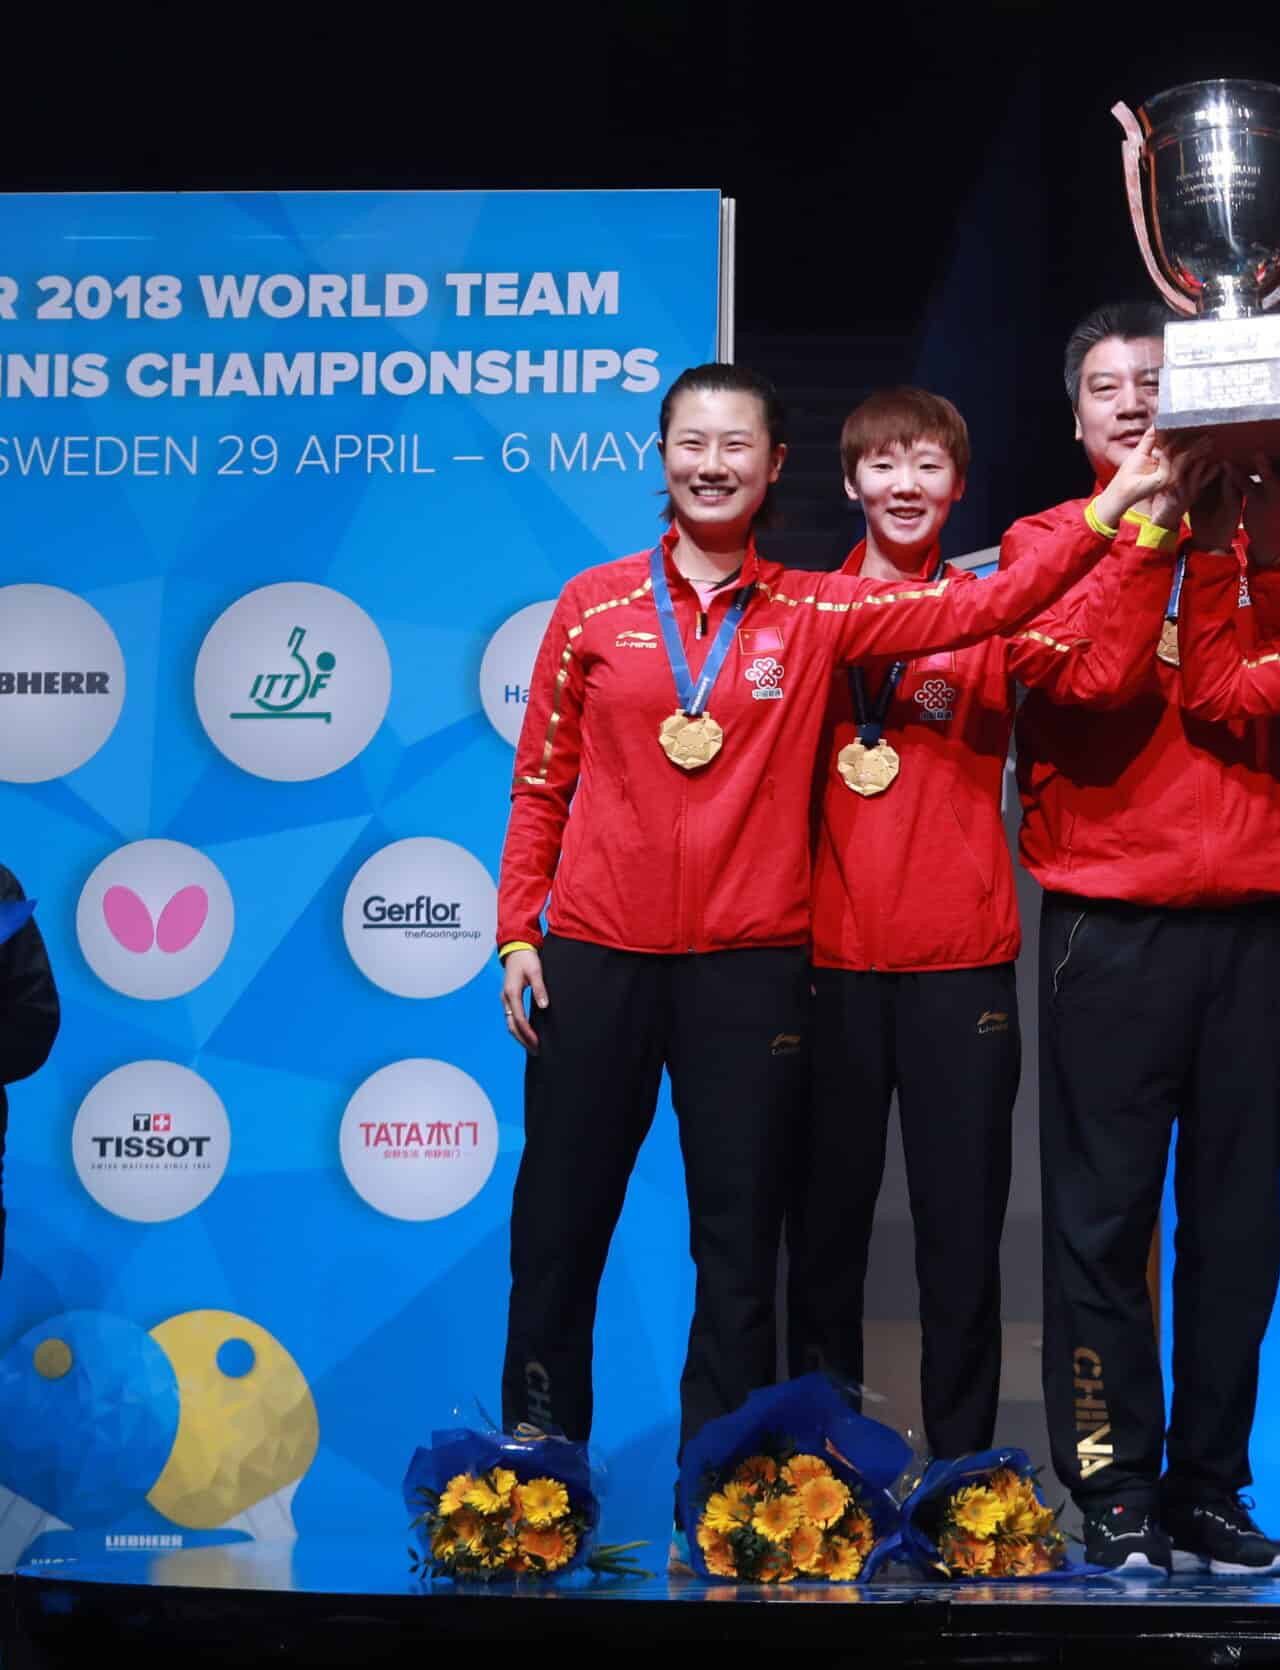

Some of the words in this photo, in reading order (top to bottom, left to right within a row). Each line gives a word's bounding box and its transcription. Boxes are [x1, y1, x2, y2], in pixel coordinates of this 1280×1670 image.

[36, 274, 182, 320] 2018
[199, 273, 429, 319] WORLD
[445, 271, 619, 317] TEAM
[0, 353, 109, 397] NIS
[125, 348, 661, 398] CHAMPIONSHIPS
[217, 434, 278, 475] 29
[295, 433, 435, 474] APRIL
[501, 432, 530, 473] 6
[549, 431, 659, 472] MAY
[0, 671, 110, 695] BHERR
[249, 673, 332, 699] ITTF
[362, 895, 461, 924] Gerflor
[91, 1136, 211, 1158] TISSOT
[1072, 1346, 1114, 1480] CHINA
